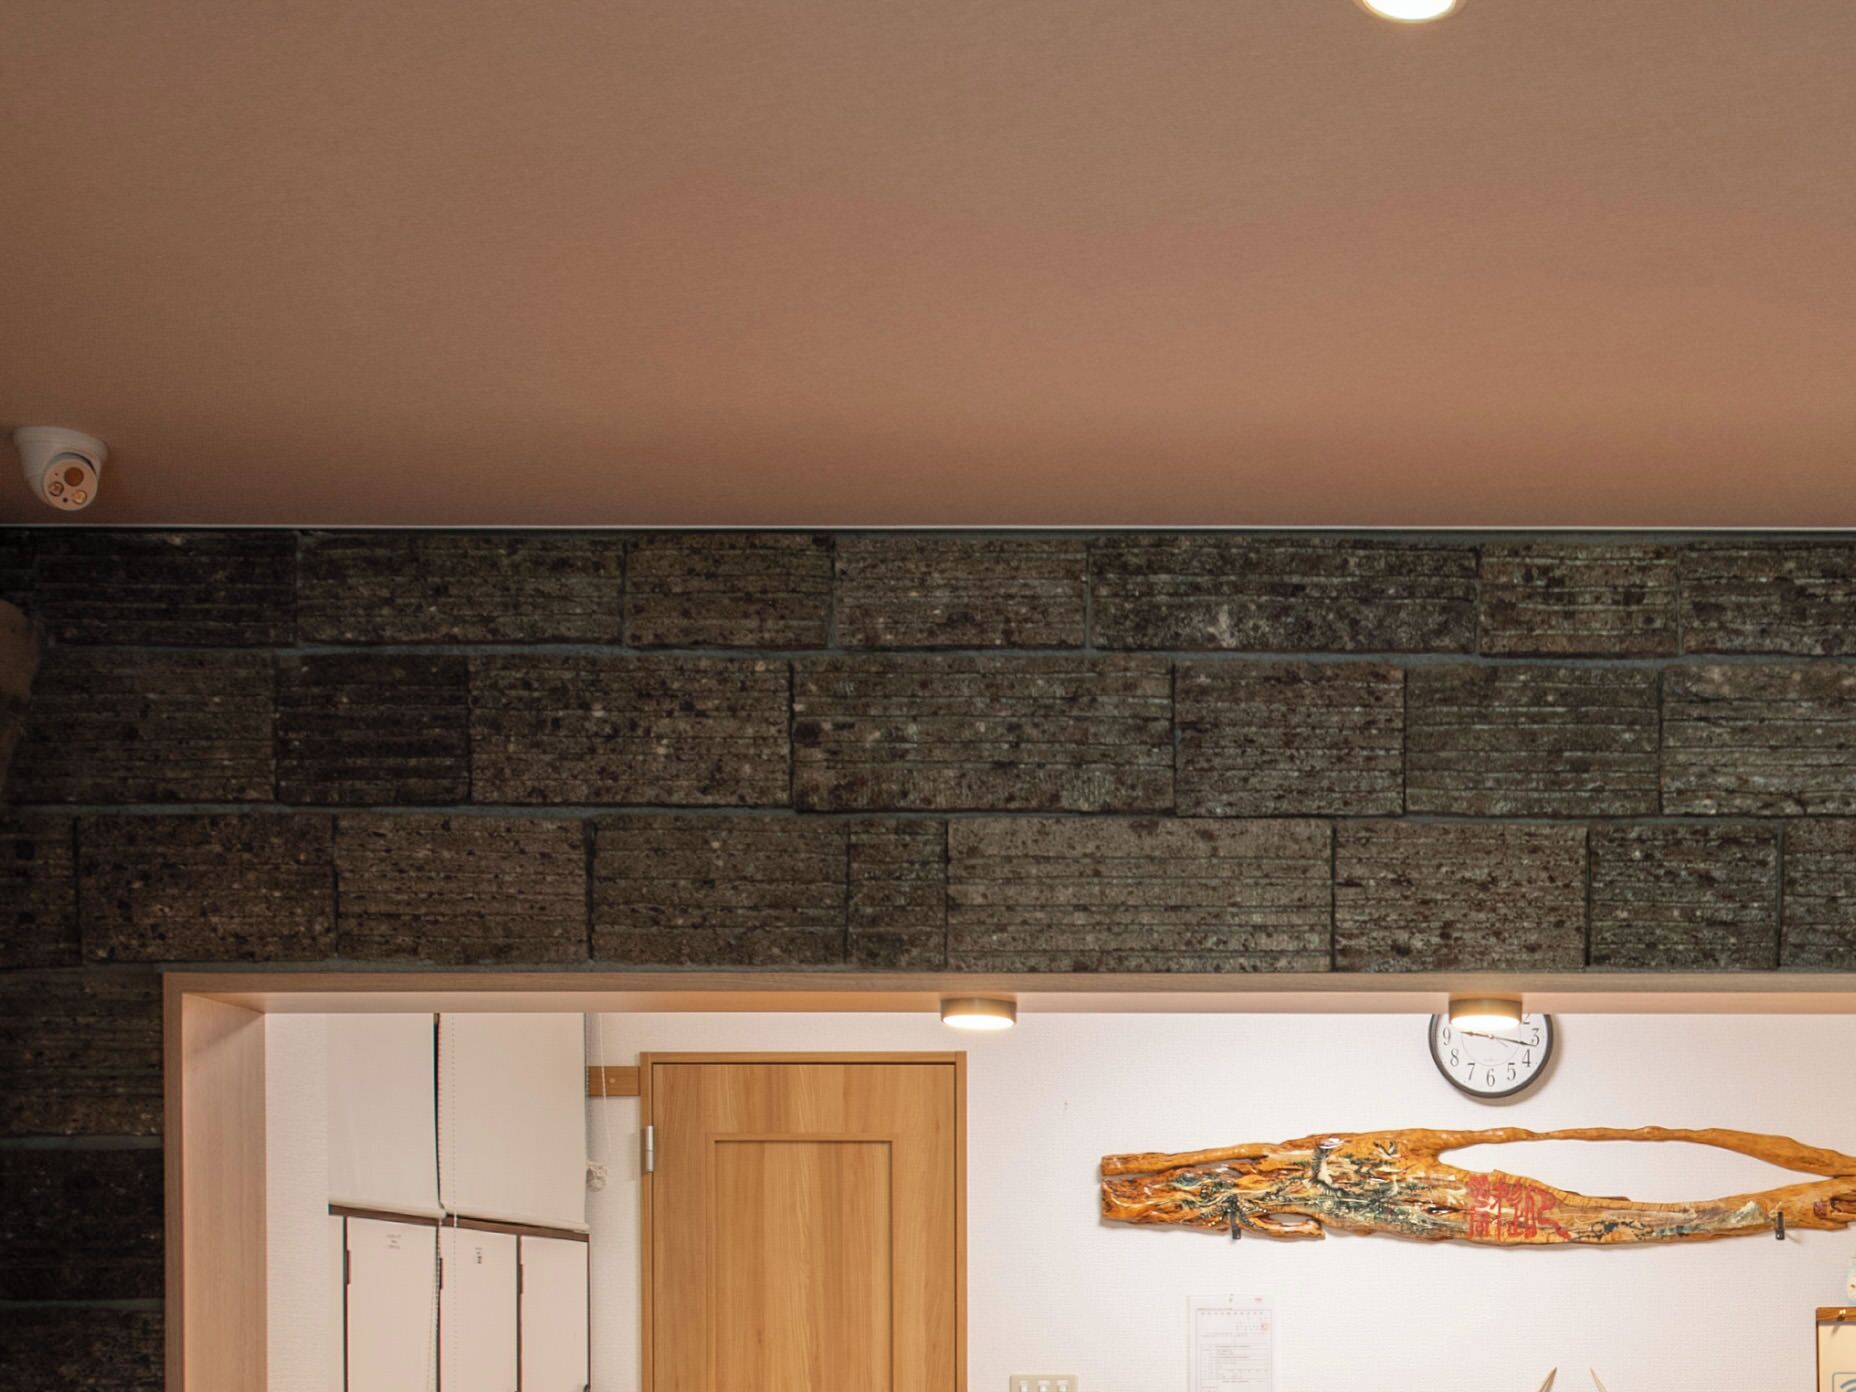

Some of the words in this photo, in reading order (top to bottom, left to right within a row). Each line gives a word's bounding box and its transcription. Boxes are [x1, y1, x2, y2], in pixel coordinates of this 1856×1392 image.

[1443, 1027, 1451, 1046] 9
[1531, 1028, 1540, 1046] 3
[1450, 1048, 1459, 1067] 8
[1522, 1049, 1531, 1068] 4
[1467, 1063, 1476, 1081] 7
[1486, 1069, 1496, 1087] 6
[1507, 1063, 1516, 1081] 5
